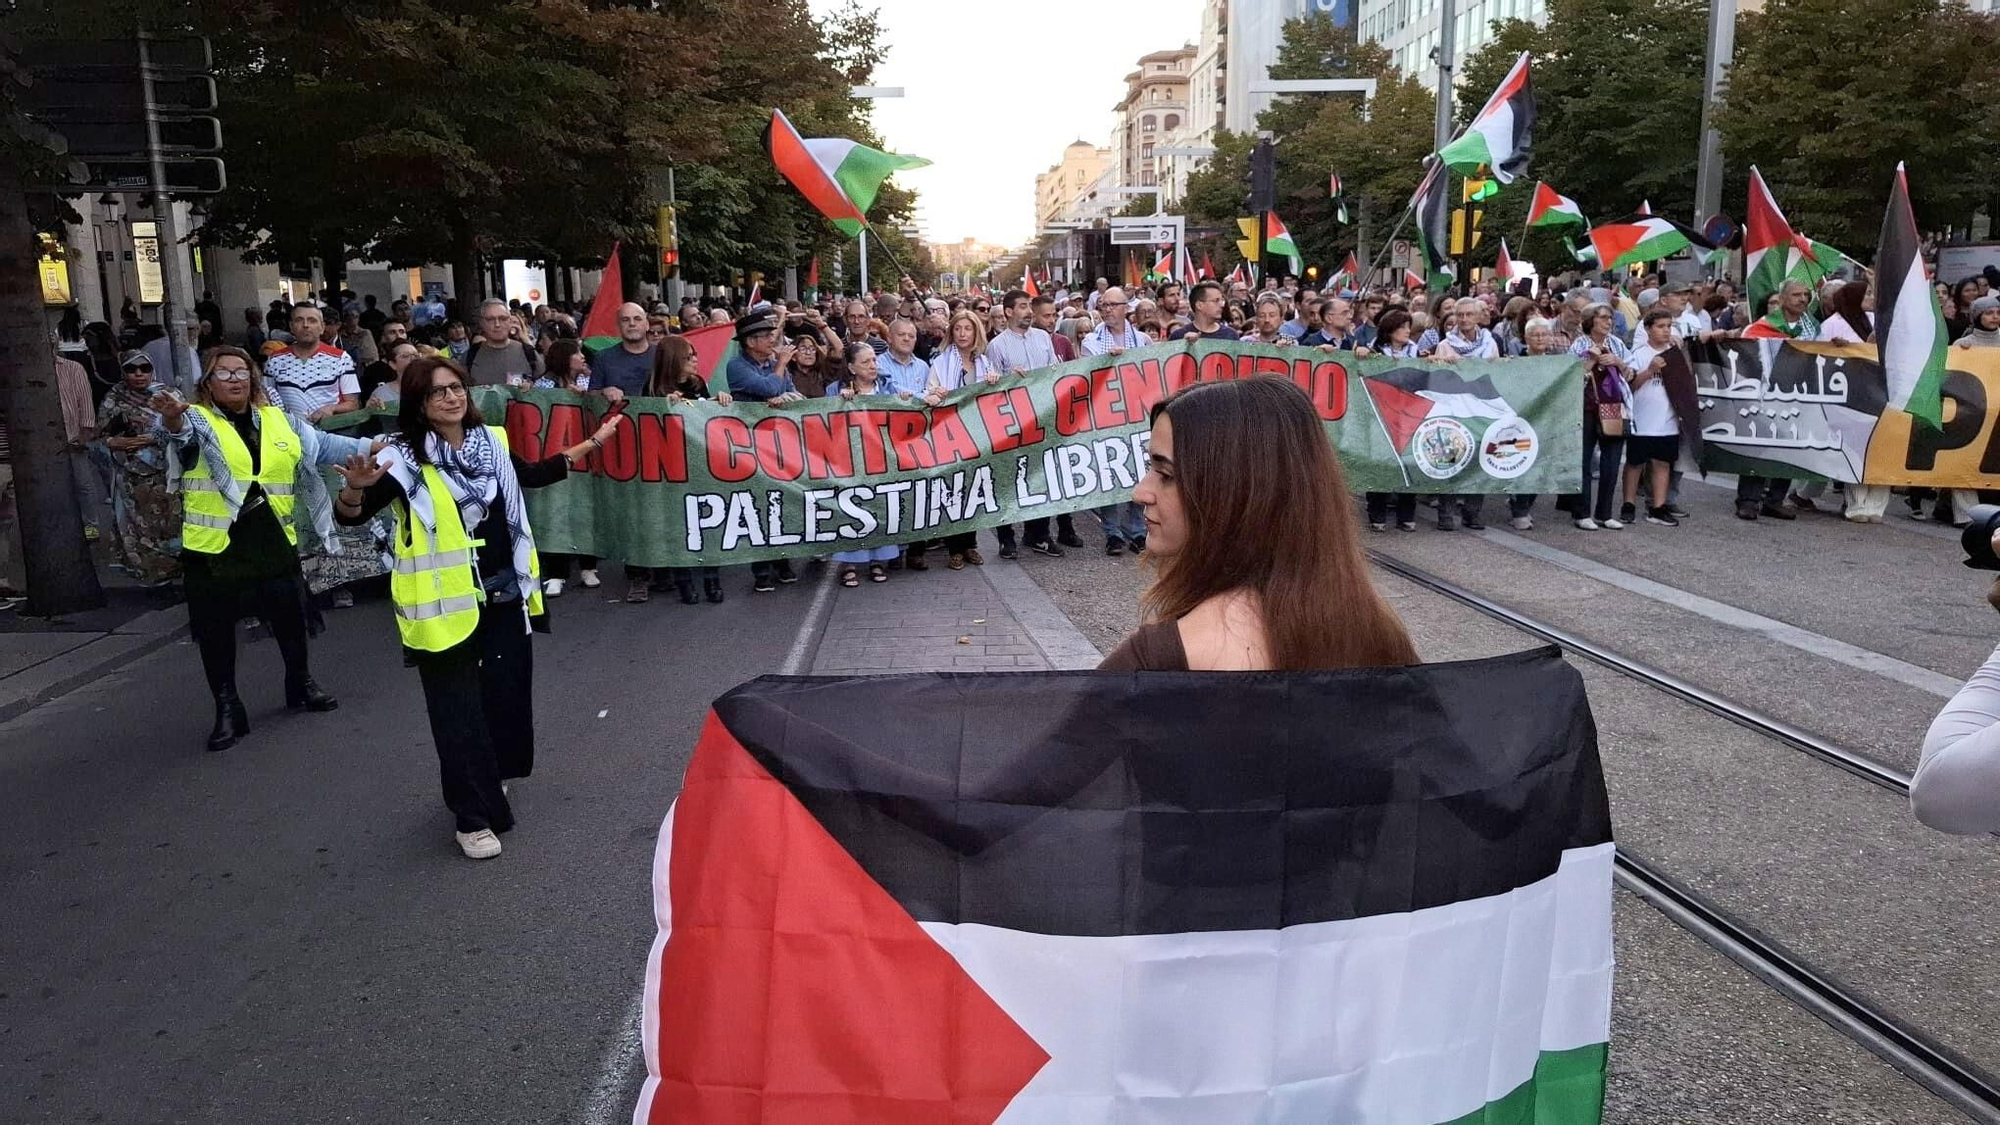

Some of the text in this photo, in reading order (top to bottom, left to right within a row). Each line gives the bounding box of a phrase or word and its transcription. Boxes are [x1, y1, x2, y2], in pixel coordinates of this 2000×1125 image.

[1695, 349, 1848, 407] فلسطي
[706, 404, 981, 482] CONTRA
[976, 386, 1044, 453] EL
[1702, 405, 1842, 450] ستنتص
[684, 465, 999, 551] PALESTINA
